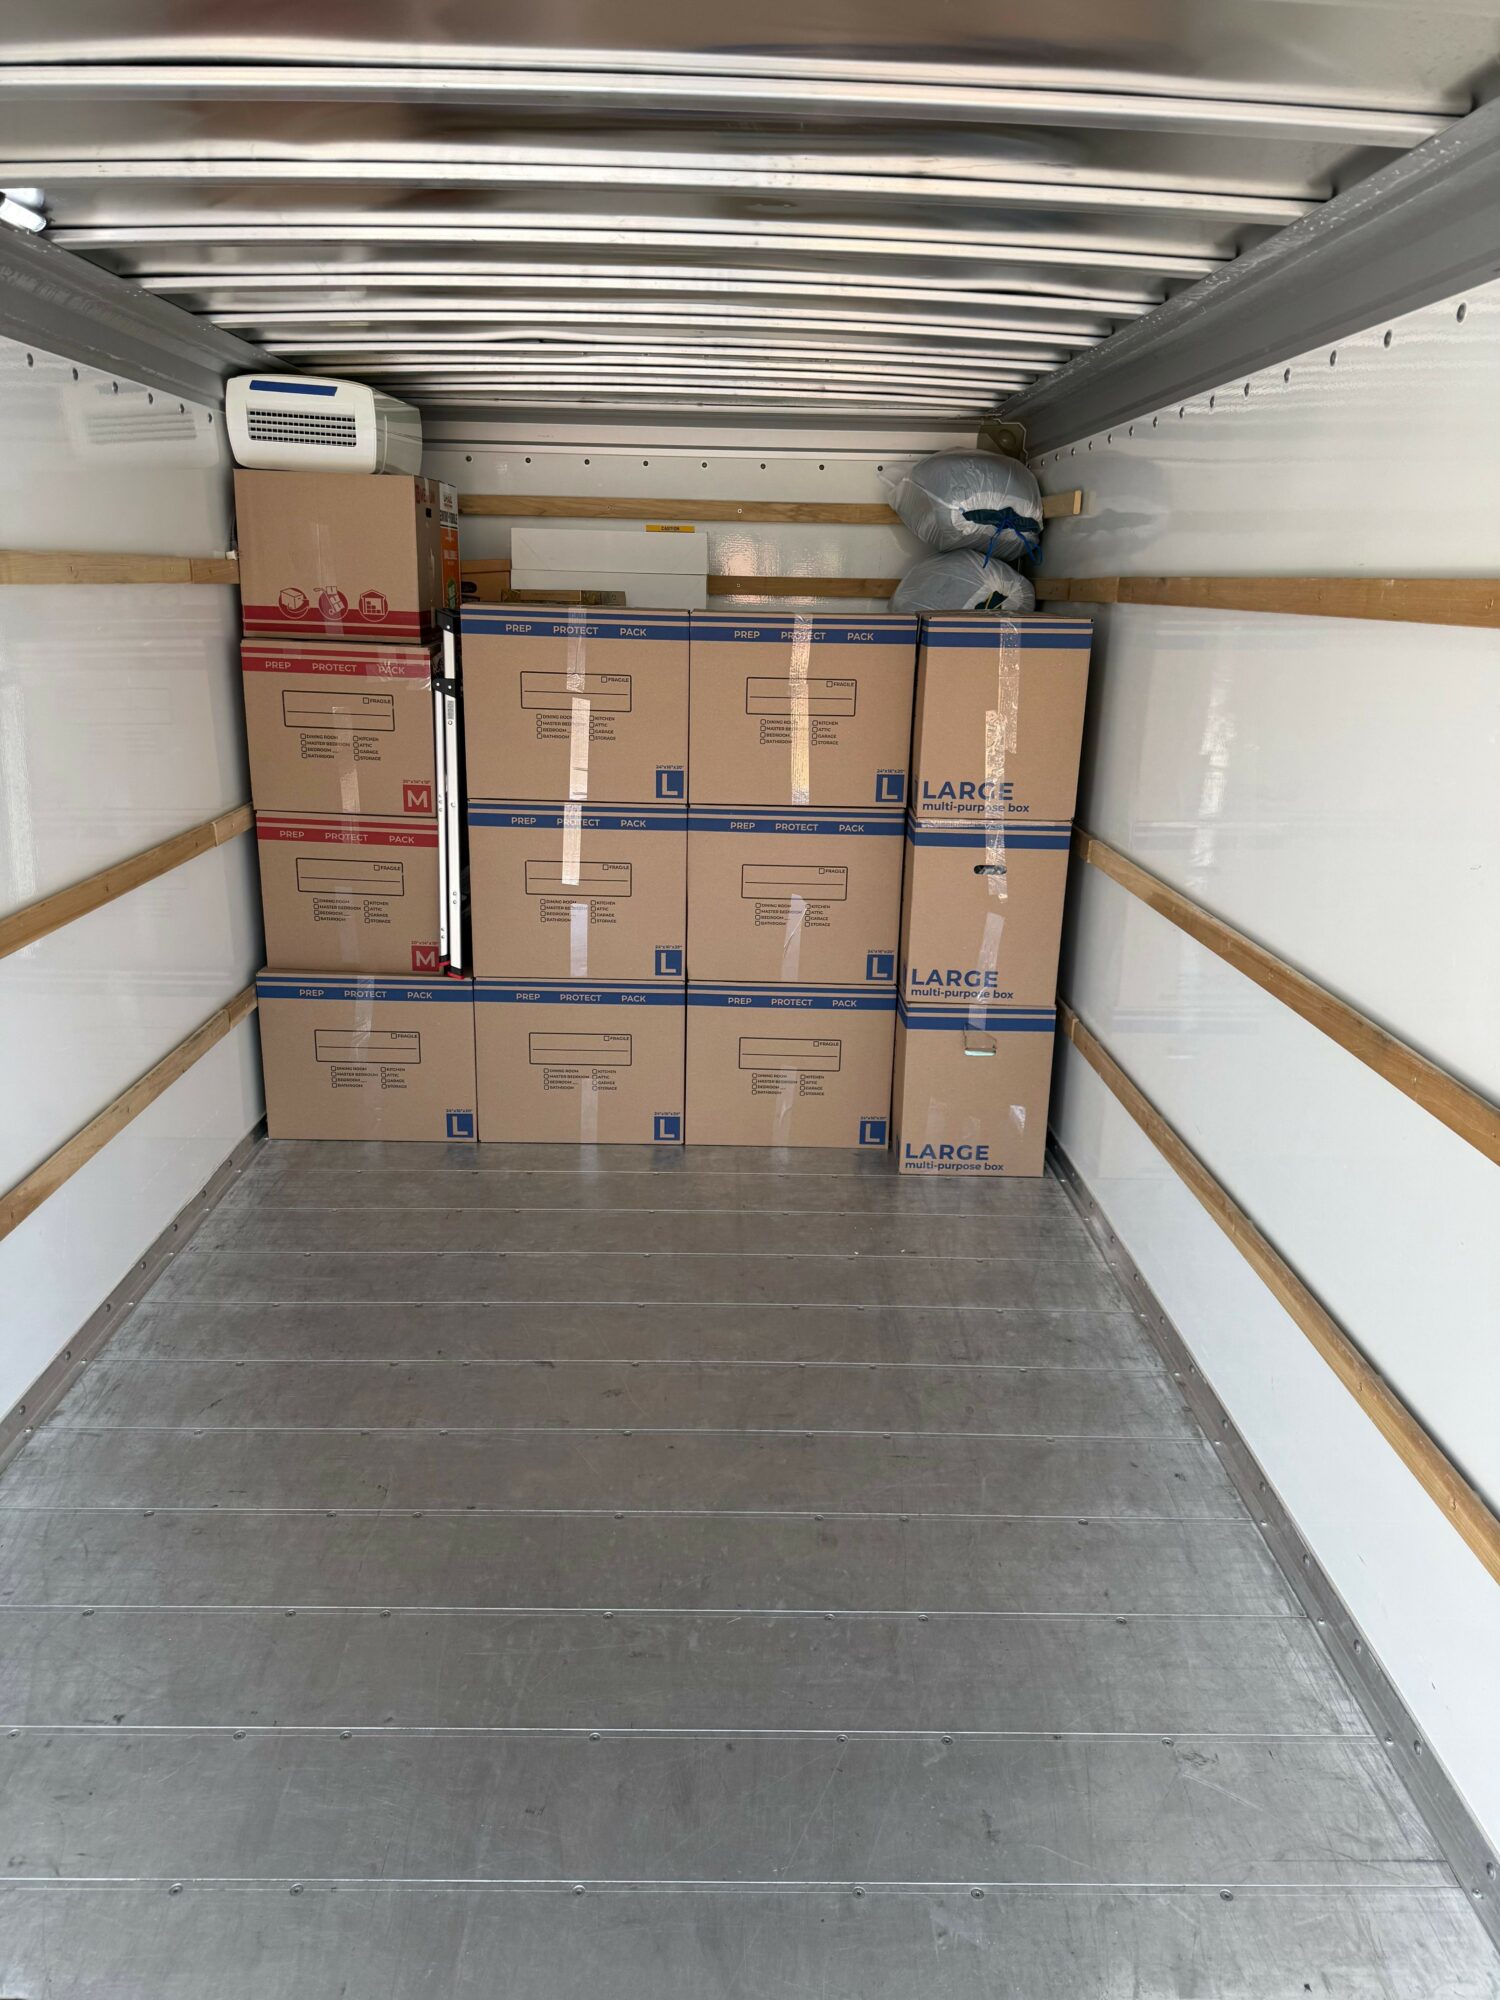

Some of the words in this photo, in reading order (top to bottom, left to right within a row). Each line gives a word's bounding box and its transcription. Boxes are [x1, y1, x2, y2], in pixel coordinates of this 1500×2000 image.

[505, 624, 532, 633] PREP
[553, 626, 599, 635] PROTECT
[620, 628, 647, 637] PACK
[734, 630, 760, 639] PREP
[781, 631, 826, 640] PROTECT
[848, 632, 874, 641] PACK
[265, 661, 291, 669] PREP
[312, 663, 357, 673] PROTECT
[662, 773, 678, 795] L
[882, 777, 898, 799] L
[923, 781, 1014, 801] LARGE
[408, 790, 428, 808] M
[1008, 803, 1029, 812] box
[511, 817, 537, 825] PREP
[556, 818, 600, 827] PROTECT
[620, 819, 646, 828] PACK
[730, 822, 755, 830] PREP
[775, 823, 819, 832] PROTECT
[839, 824, 864, 833] PACK
[280, 830, 305, 838] PREP
[325, 832, 368, 841] PROTECT
[389, 835, 415, 844] PACK
[416, 951, 435, 968] M
[661, 953, 676, 973] L
[872, 957, 888, 977] L
[912, 968, 999, 988] LARGE
[299, 989, 325, 997] PREP
[344, 990, 387, 998] PROTECT
[407, 991, 433, 999] PACK
[560, 994, 602, 1002] PROTECT
[621, 995, 646, 1003] PACK
[993, 990, 1014, 999] box
[771, 998, 813, 1006] PROTECT
[452, 1116, 468, 1135] L
[660, 1119, 675, 1138] L
[865, 1123, 880, 1142] L
[905, 1143, 989, 1161] LARGE
[905, 1161, 981, 1171] multi-purpose
[984, 1163, 1004, 1171] box
